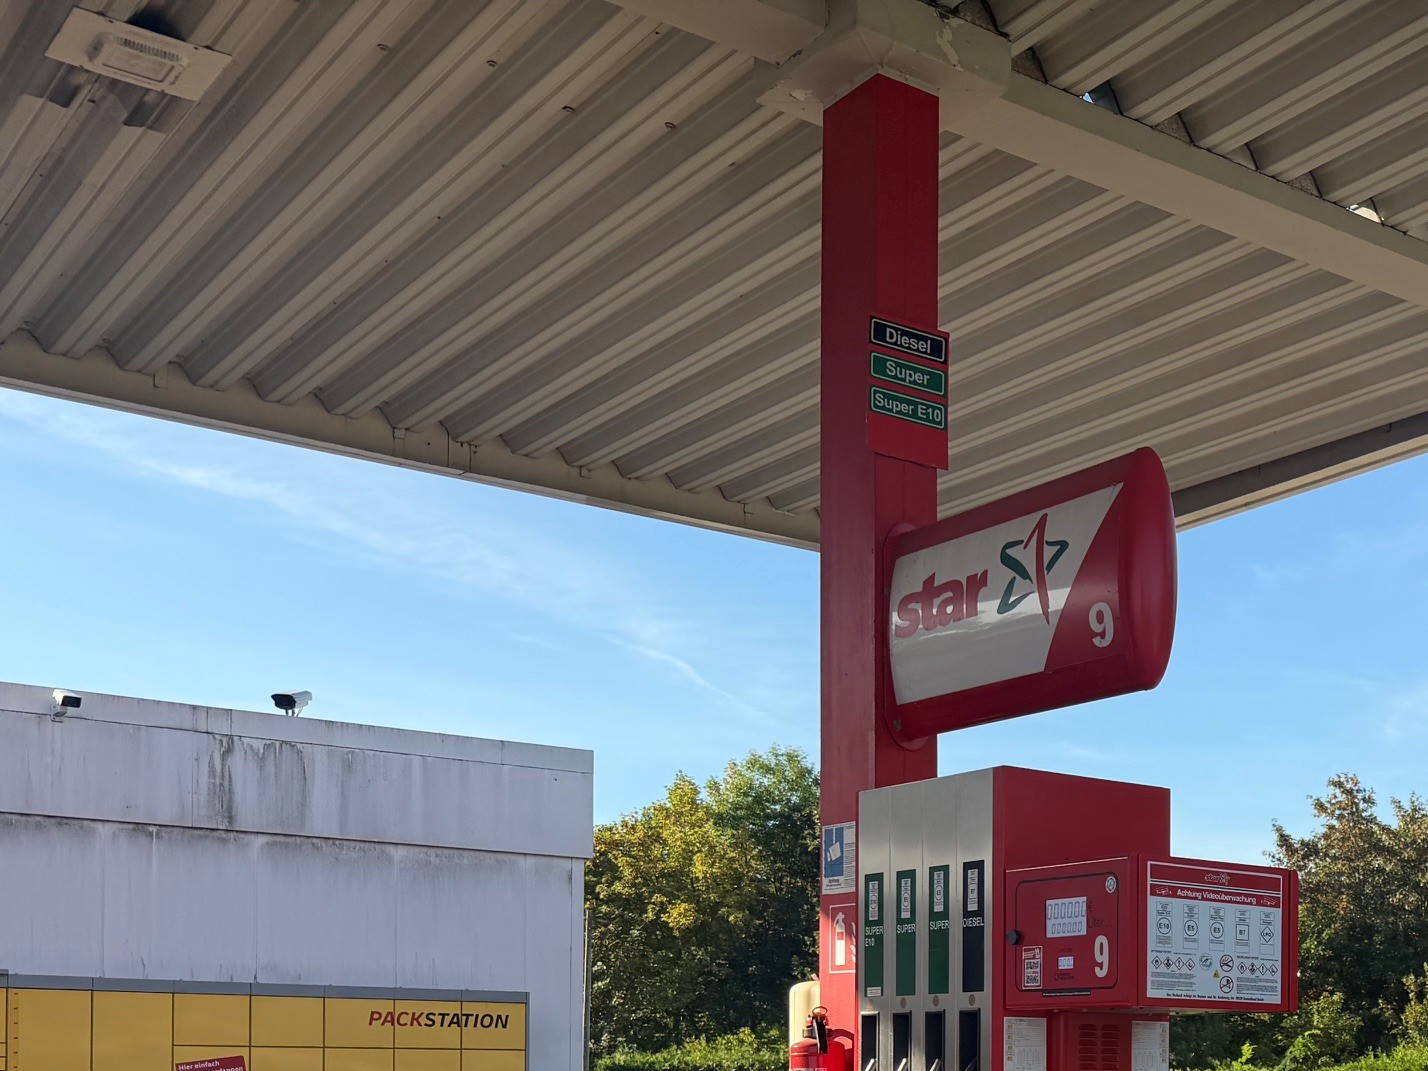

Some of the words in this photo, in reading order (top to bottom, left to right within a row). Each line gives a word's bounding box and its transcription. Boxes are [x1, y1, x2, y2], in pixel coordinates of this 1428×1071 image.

[885, 327, 931, 354] Diesel
[885, 361, 930, 385] Super
[875, 393, 914, 414] Super
[917, 404, 941, 422] E10
[895, 569, 988, 639] star
[1088, 601, 1114, 648] 9
[1176, 889, 1202, 900] Achtung
[1202, 891, 1257, 905] Videoüberwachung
[865, 925, 884, 935] SUPER
[896, 923, 916, 933] SUPER
[930, 920, 950, 930] SUPER
[962, 916, 985, 927] DIESEL
[1094, 934, 1109, 978] 9
[368, 1011, 509, 1029] PACKSTATION
[194, 1060, 220, 1069] einfach
